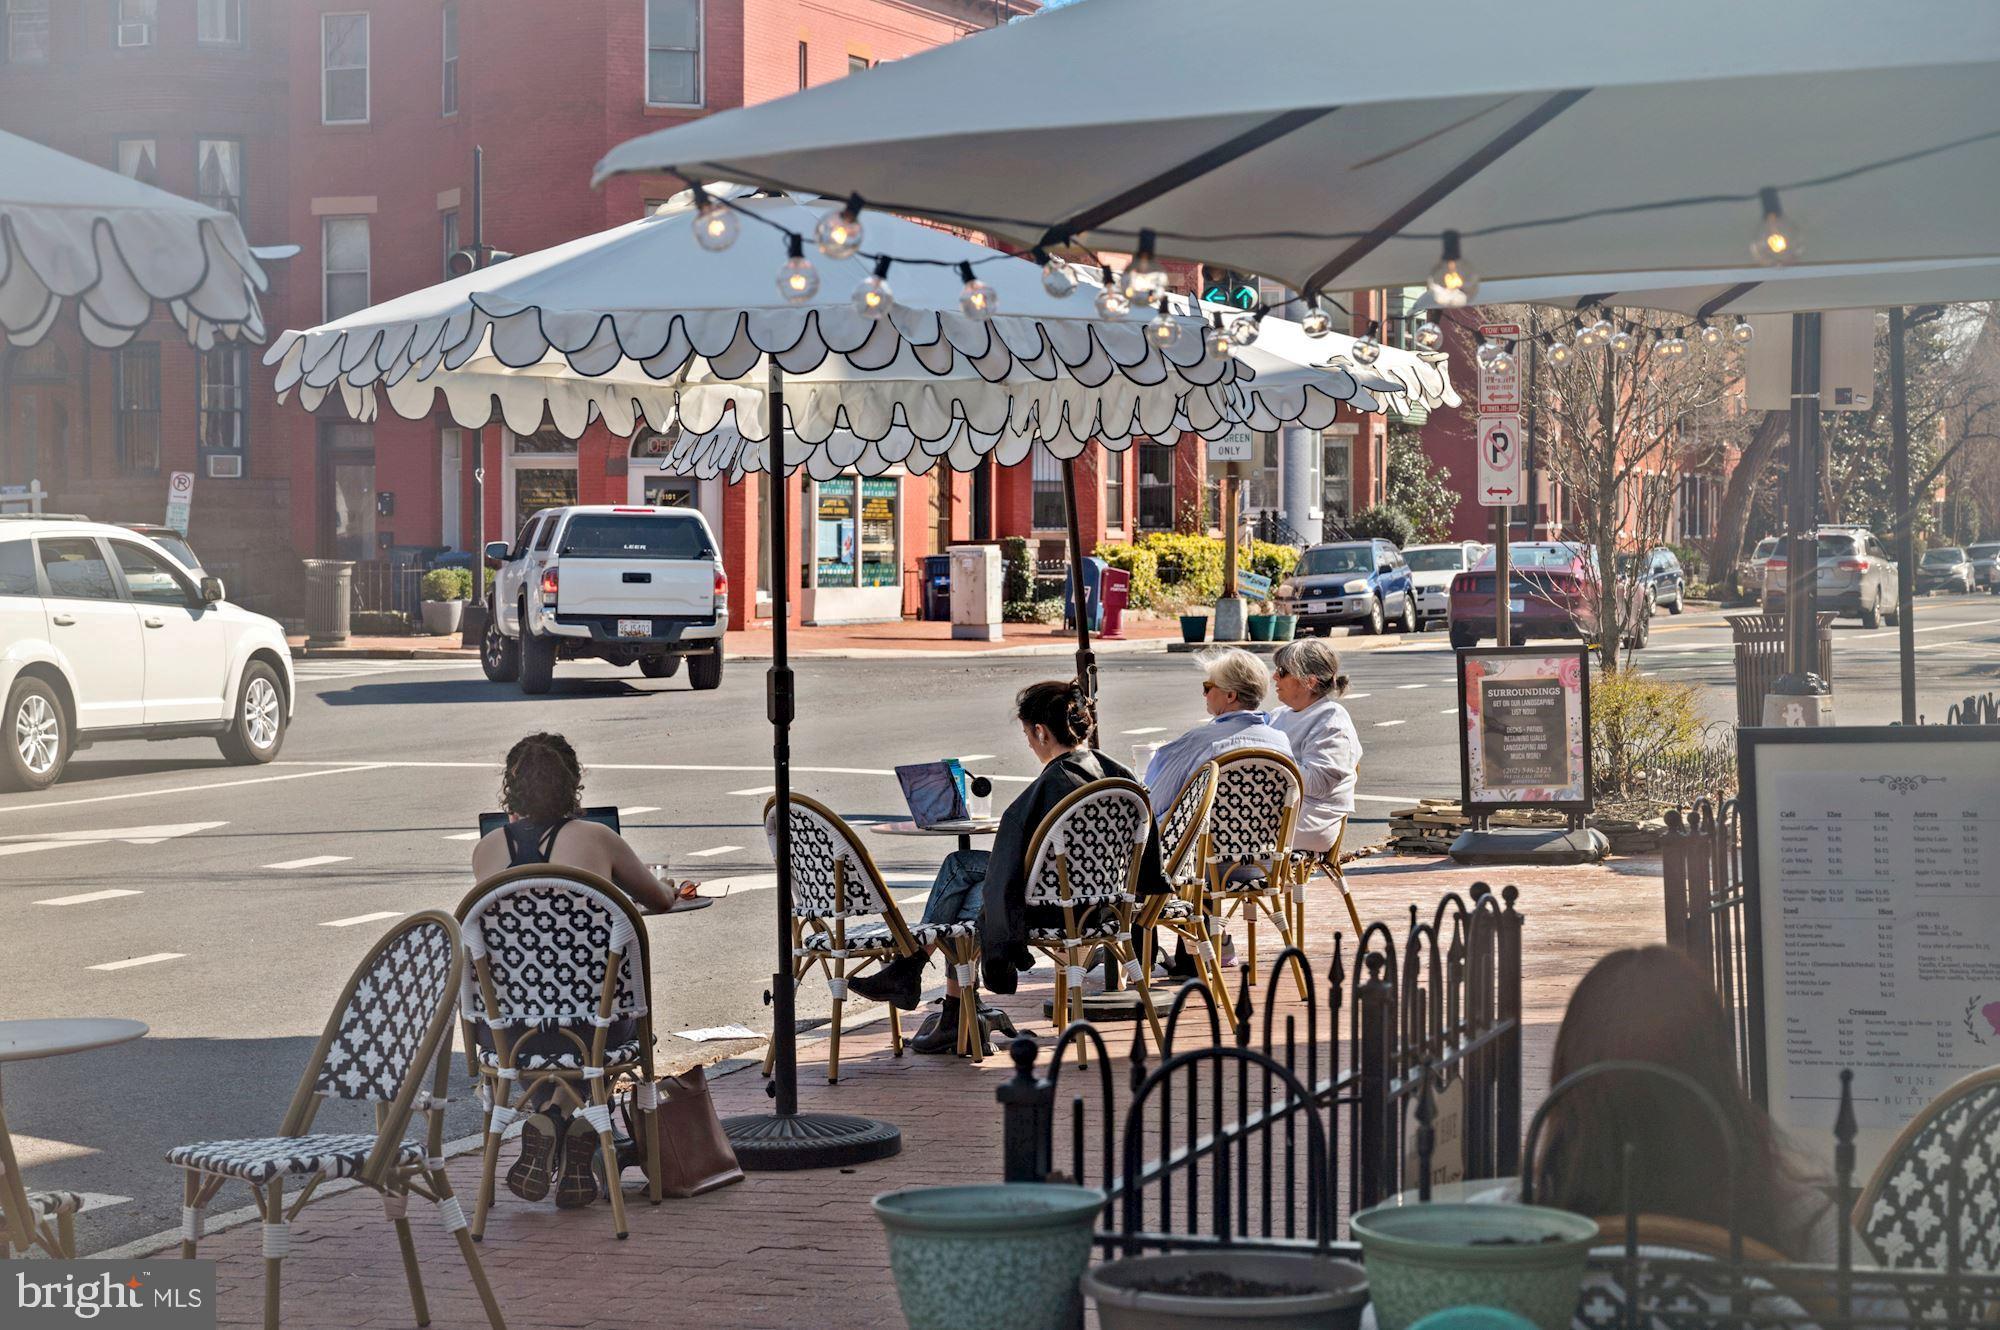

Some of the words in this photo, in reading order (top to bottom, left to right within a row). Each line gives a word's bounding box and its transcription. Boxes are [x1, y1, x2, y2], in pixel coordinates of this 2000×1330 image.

[650, 439, 674, 452] OPE
[1218, 446, 1240, 455] ONLY
[1488, 688, 1560, 697] SURROUNDINGS
[1894, 1076, 1935, 1086] WINE
[1910, 1087, 1919, 1095] &
[1885, 1096, 1934, 1106] BUTT
